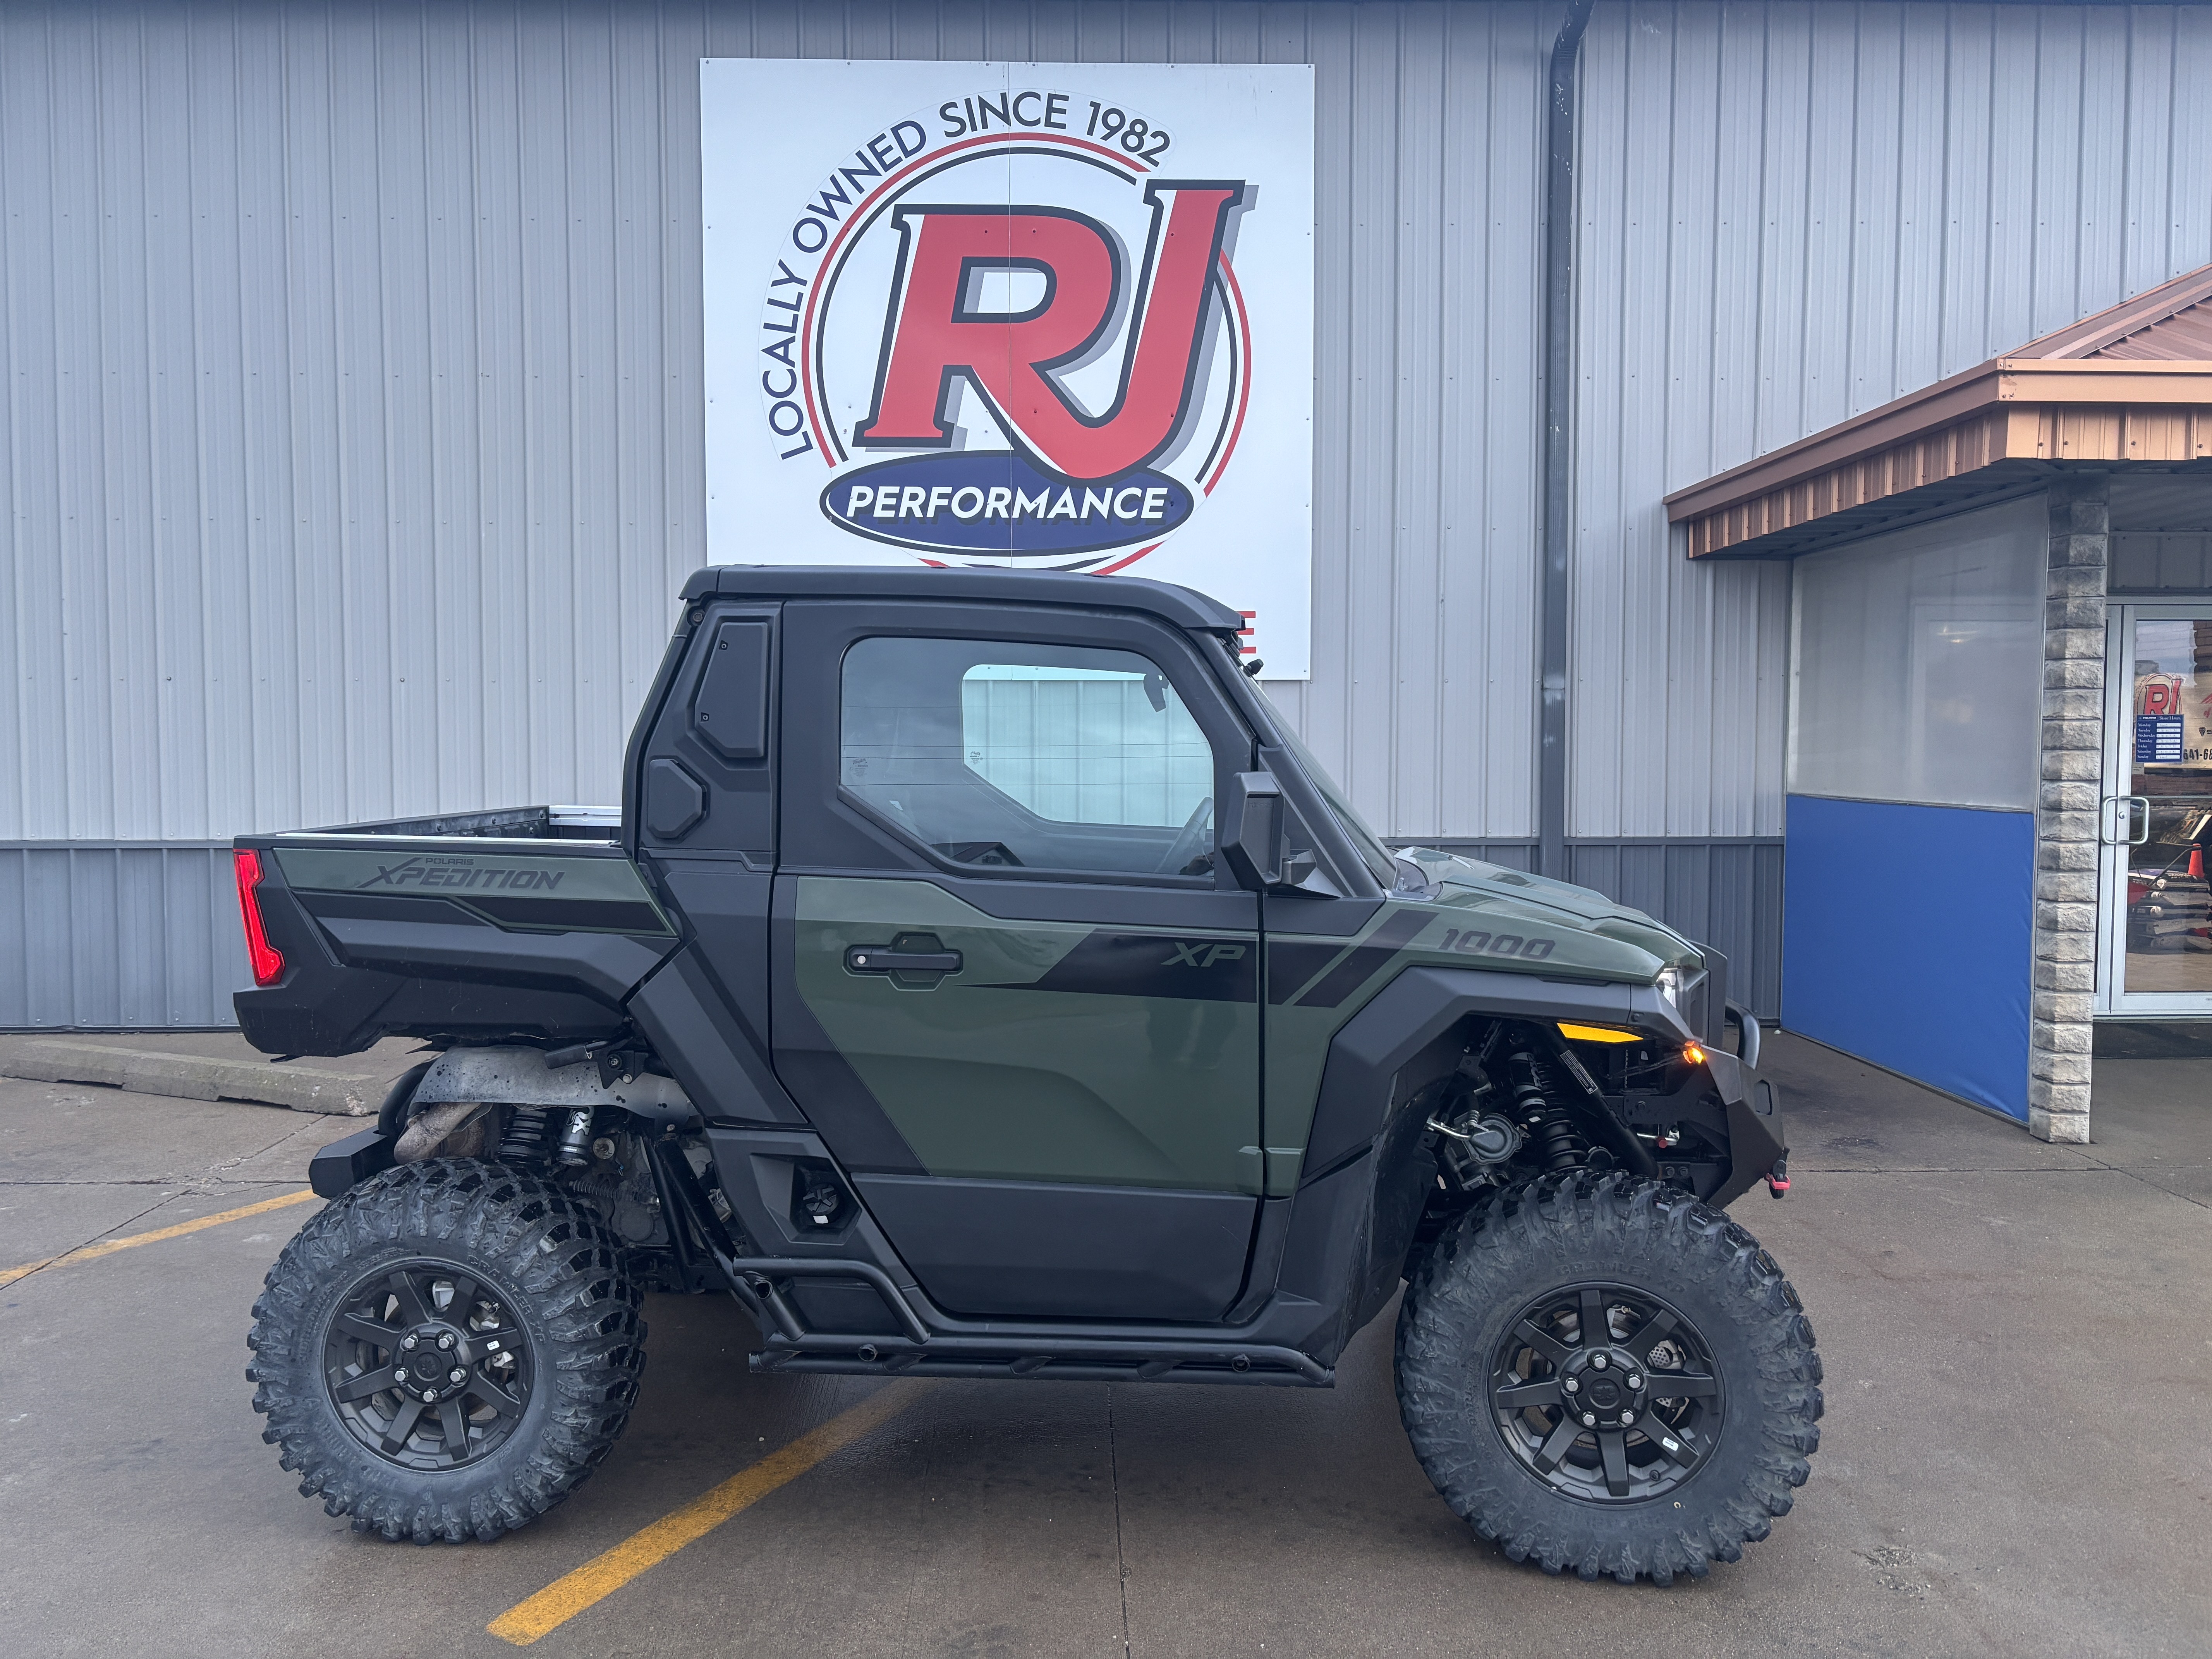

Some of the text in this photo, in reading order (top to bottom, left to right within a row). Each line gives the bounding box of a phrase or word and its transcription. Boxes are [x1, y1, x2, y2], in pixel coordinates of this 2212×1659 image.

[761, 91, 1170, 460] LOCALLY OWNED SINCE 1982
[852, 179, 1246, 482] RJ
[846, 486, 1168, 519] PERFORMANCE
[357, 857, 565, 890] XPEDITION
[426, 857, 474, 866] POLARIS
[1161, 942, 1247, 967] XP
[1438, 928, 1556, 960] 1000
